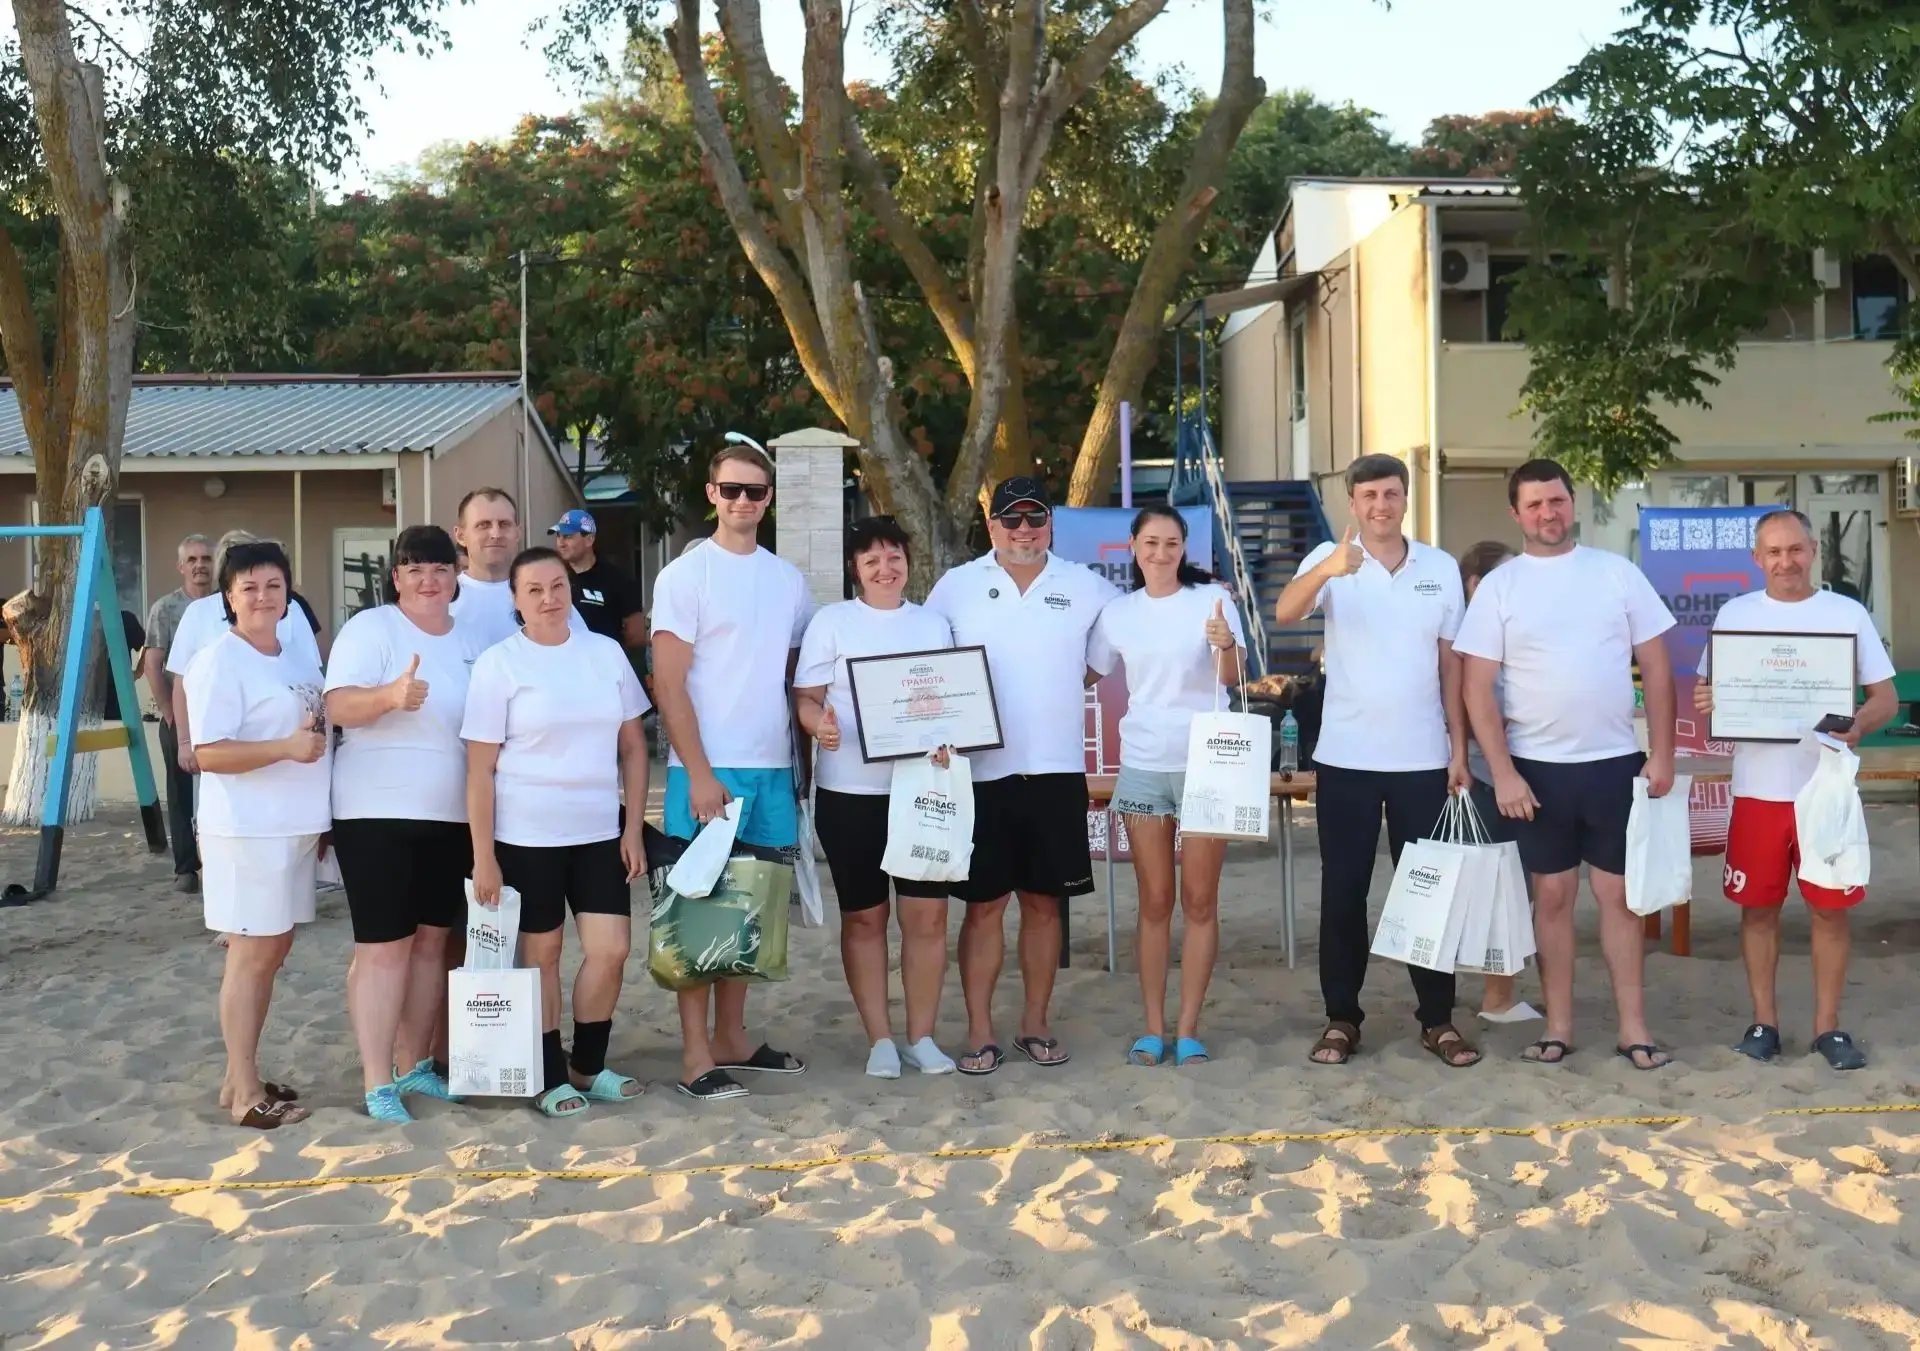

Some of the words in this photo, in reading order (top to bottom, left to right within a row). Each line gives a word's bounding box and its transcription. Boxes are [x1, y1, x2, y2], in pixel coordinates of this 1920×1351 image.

[1761, 658, 1807, 669] ГРАМОТА
[901, 676, 945, 688] ГРАМОТА
[1206, 738, 1252, 747] ДОНБАСС
[1207, 744, 1252, 752] ТЕПЛОЭНЕРГО
[914, 796, 957, 811] ДОНБАСС
[1409, 868, 1442, 881] ДОНБАСС
[1724, 863, 1747, 894] 99
[466, 999, 512, 1008] ДОНБАСС
